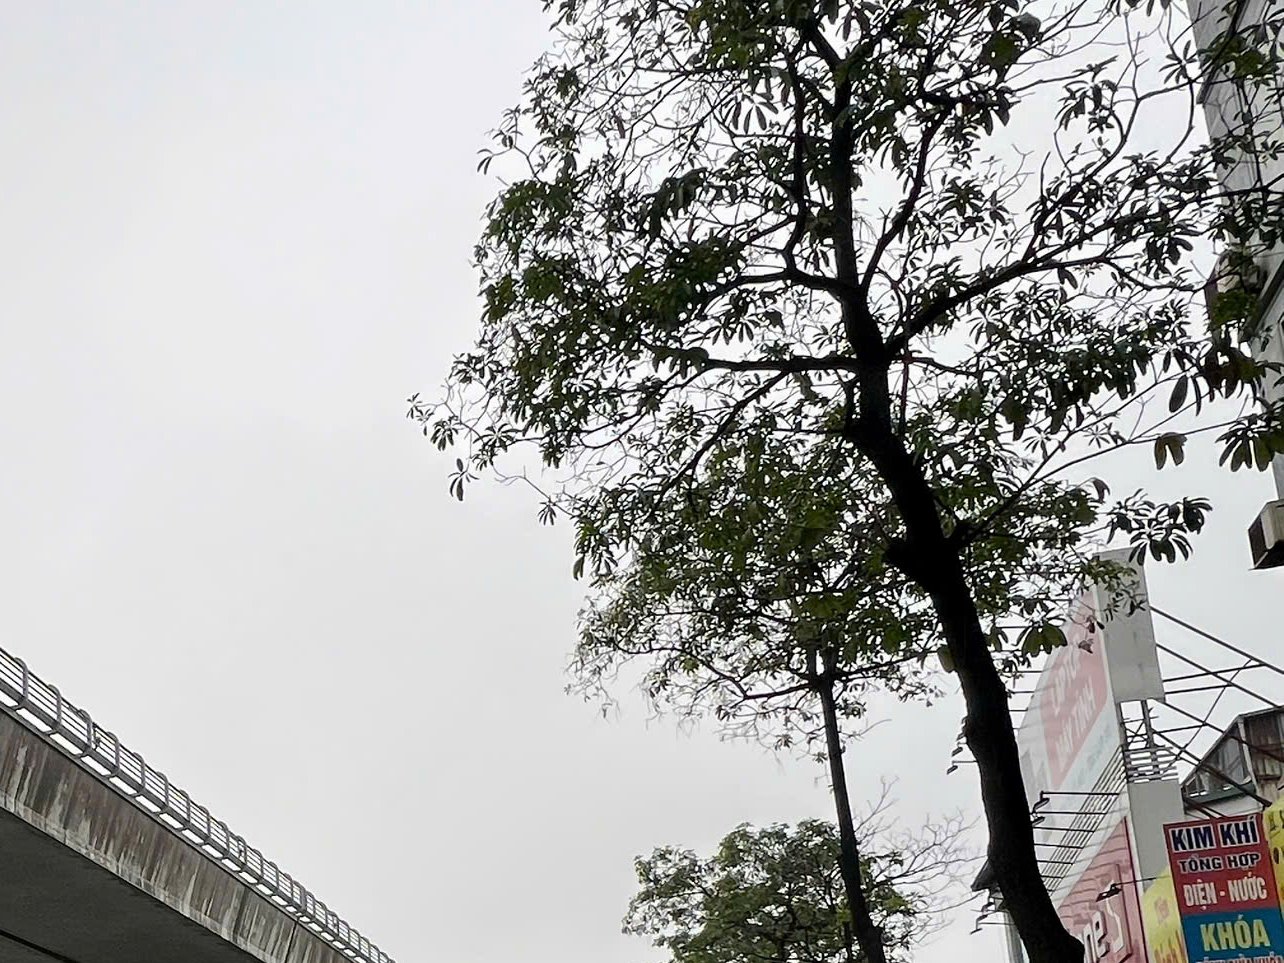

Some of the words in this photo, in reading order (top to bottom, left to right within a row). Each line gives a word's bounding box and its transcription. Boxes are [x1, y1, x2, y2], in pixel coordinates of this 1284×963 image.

[1170, 825, 1215, 852] KIM
[1219, 816, 1259, 846] KHÍ
[1179, 854, 1223, 872] TỔNG
[1227, 853, 1260, 870] HỢP
[1183, 879, 1217, 910] ĐIỆN
[1227, 872, 1268, 902] NƯỚC
[1200, 914, 1271, 951] KHÓA
